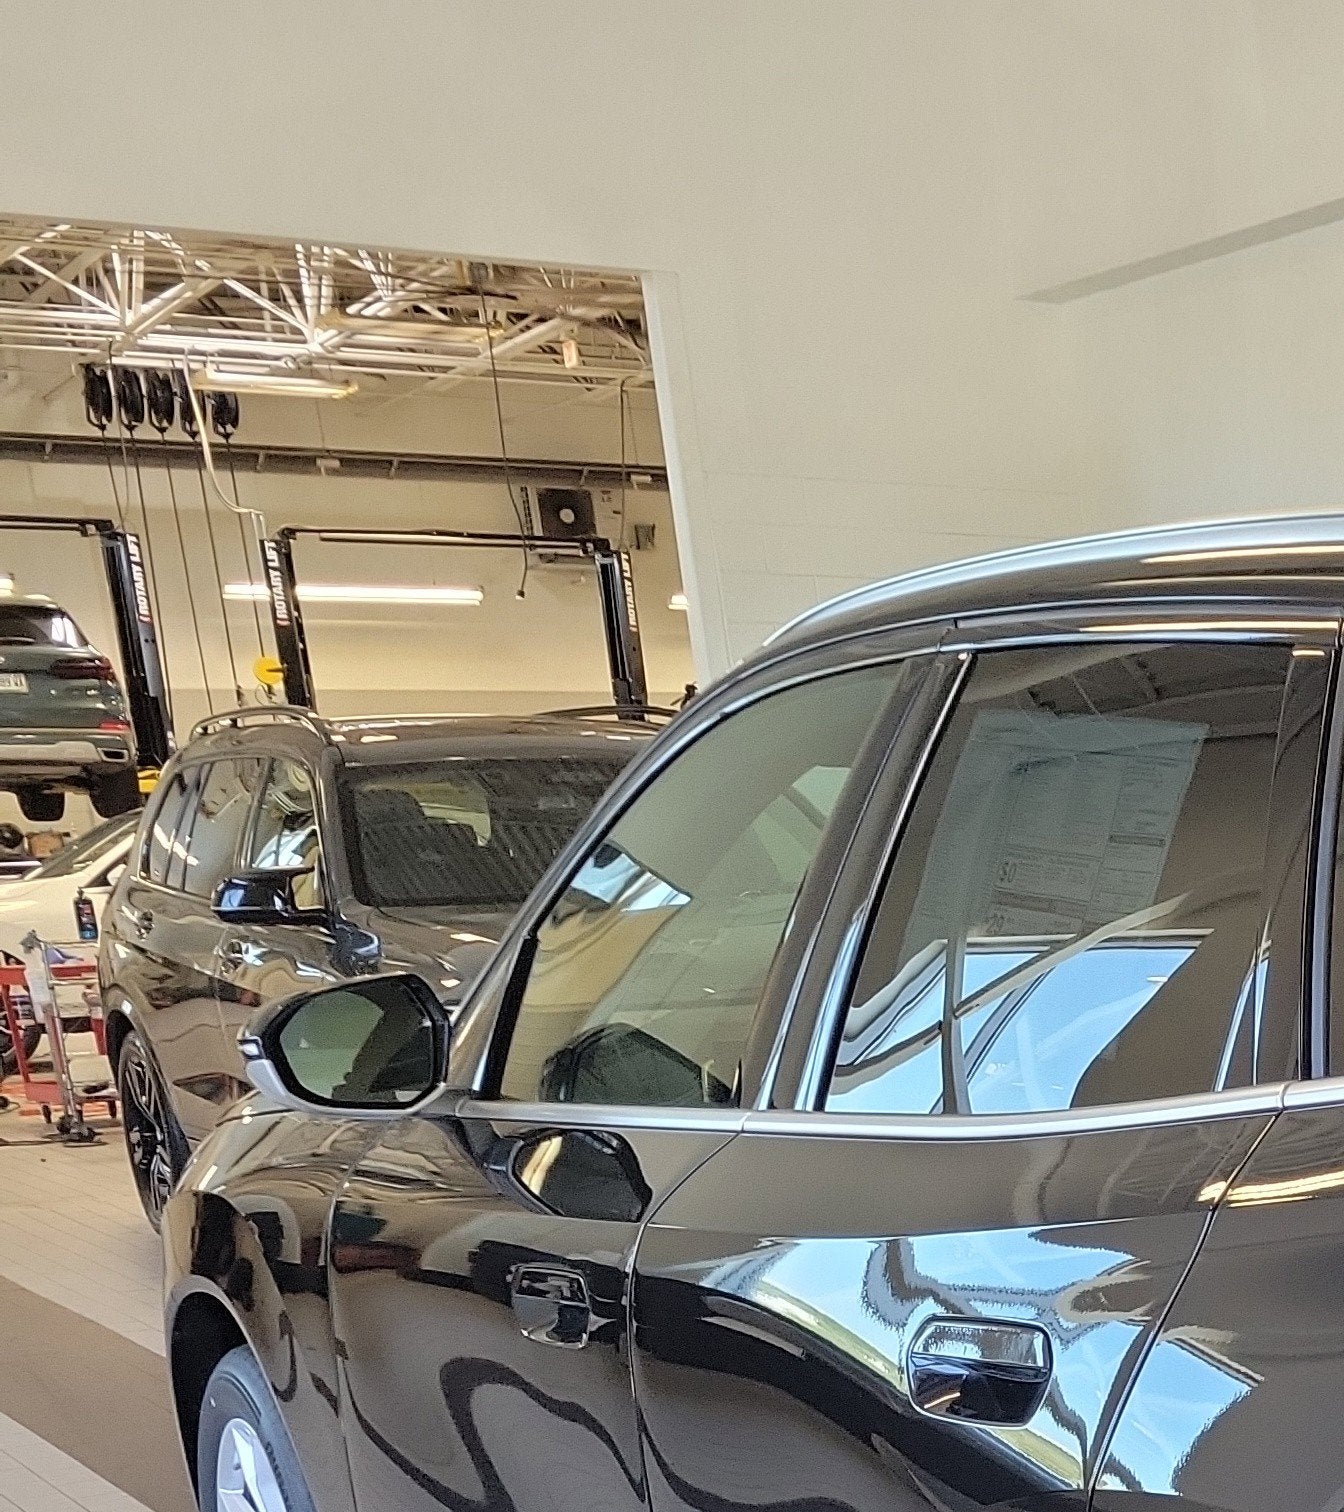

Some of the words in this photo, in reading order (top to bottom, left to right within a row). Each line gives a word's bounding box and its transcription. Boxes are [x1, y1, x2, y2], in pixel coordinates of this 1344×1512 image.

[125, 533, 142, 563] LIFT
[263, 540, 280, 567] LIFT
[131, 563, 150, 616] ROTARY
[268, 568, 288, 618] ROTARY
